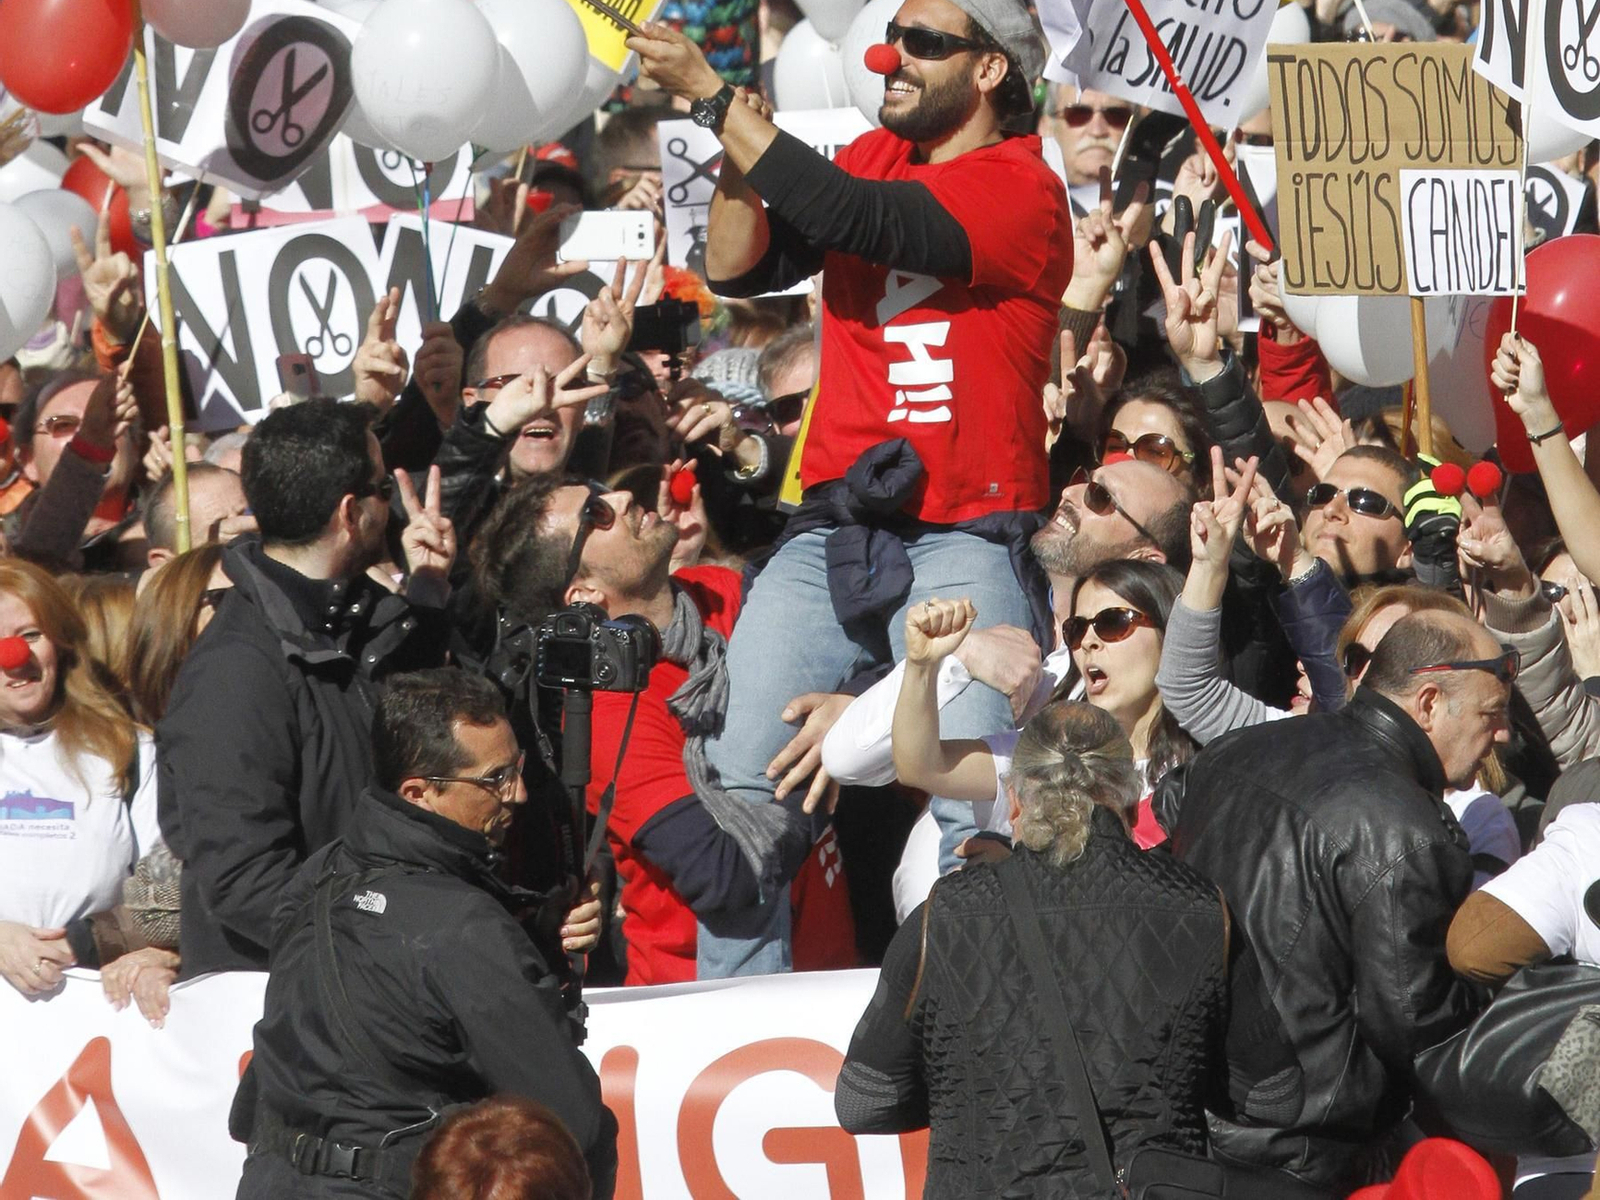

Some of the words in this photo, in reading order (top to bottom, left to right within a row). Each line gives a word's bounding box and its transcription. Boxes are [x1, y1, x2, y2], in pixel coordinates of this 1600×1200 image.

[1098, 9, 1131, 76] la
[1267, 54, 1391, 165] TODOS
[1392, 52, 1518, 165] SOMOS
[1408, 176, 1526, 293] CANDEL
